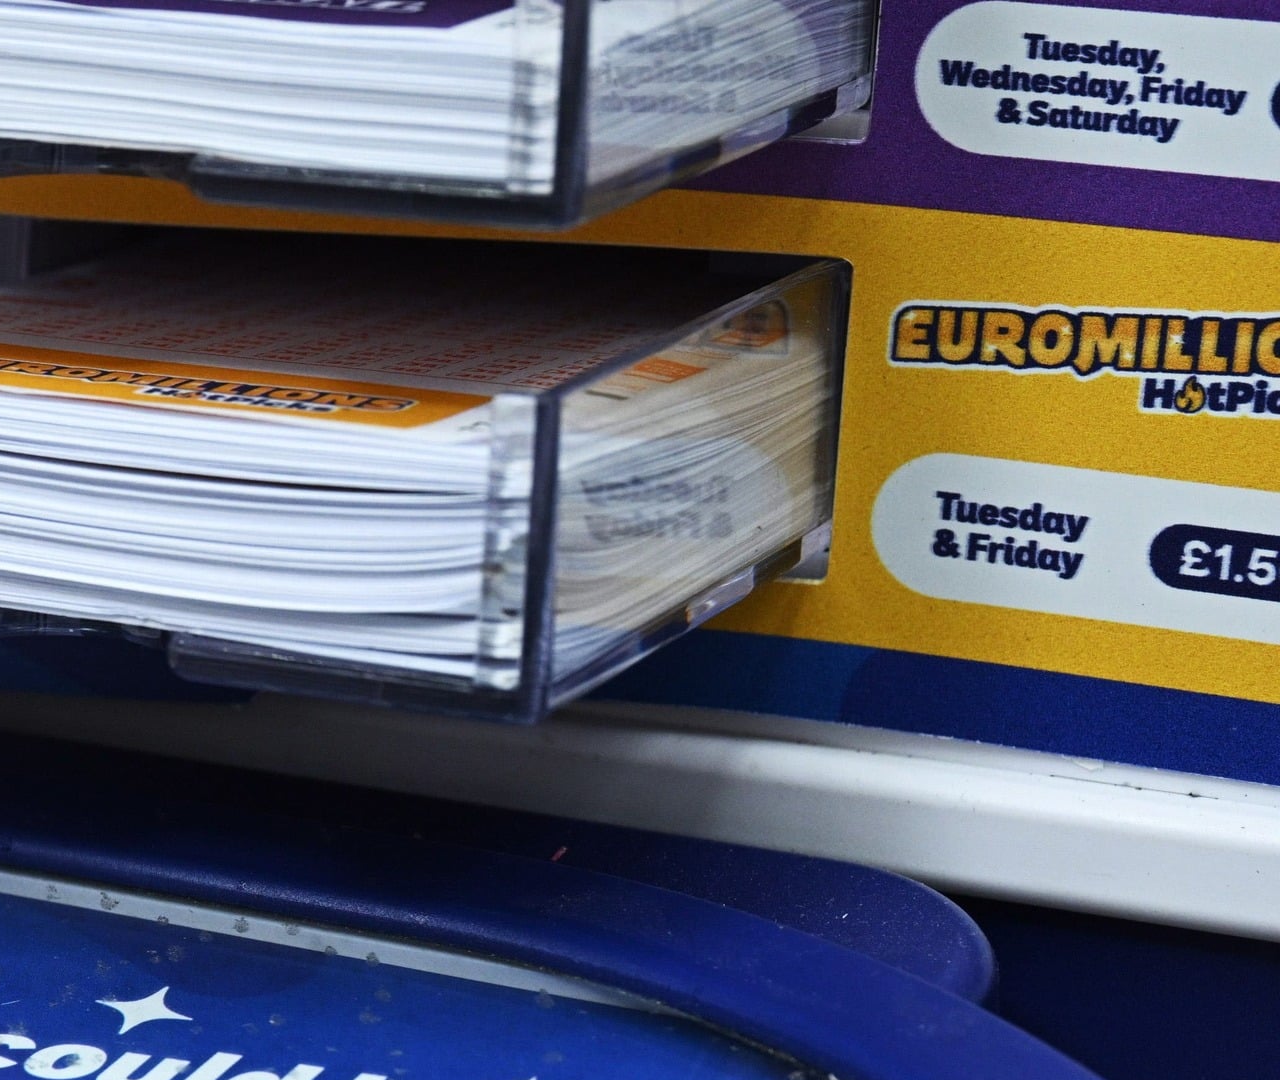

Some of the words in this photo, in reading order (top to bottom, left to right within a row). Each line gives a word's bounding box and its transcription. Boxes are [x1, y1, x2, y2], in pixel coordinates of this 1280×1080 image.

[1024, 33, 1165, 73] Tuesday,
[940, 59, 1135, 106] Wednesday,
[1141, 76, 1246, 114] Friday
[997, 99, 1021, 124] &
[1027, 101, 1180, 143] Saturday
[936, 491, 1088, 542] Tuesday
[932, 530, 960, 558] &
[967, 533, 1083, 579] Friday
[1179, 540, 1280, 586] £1.5
